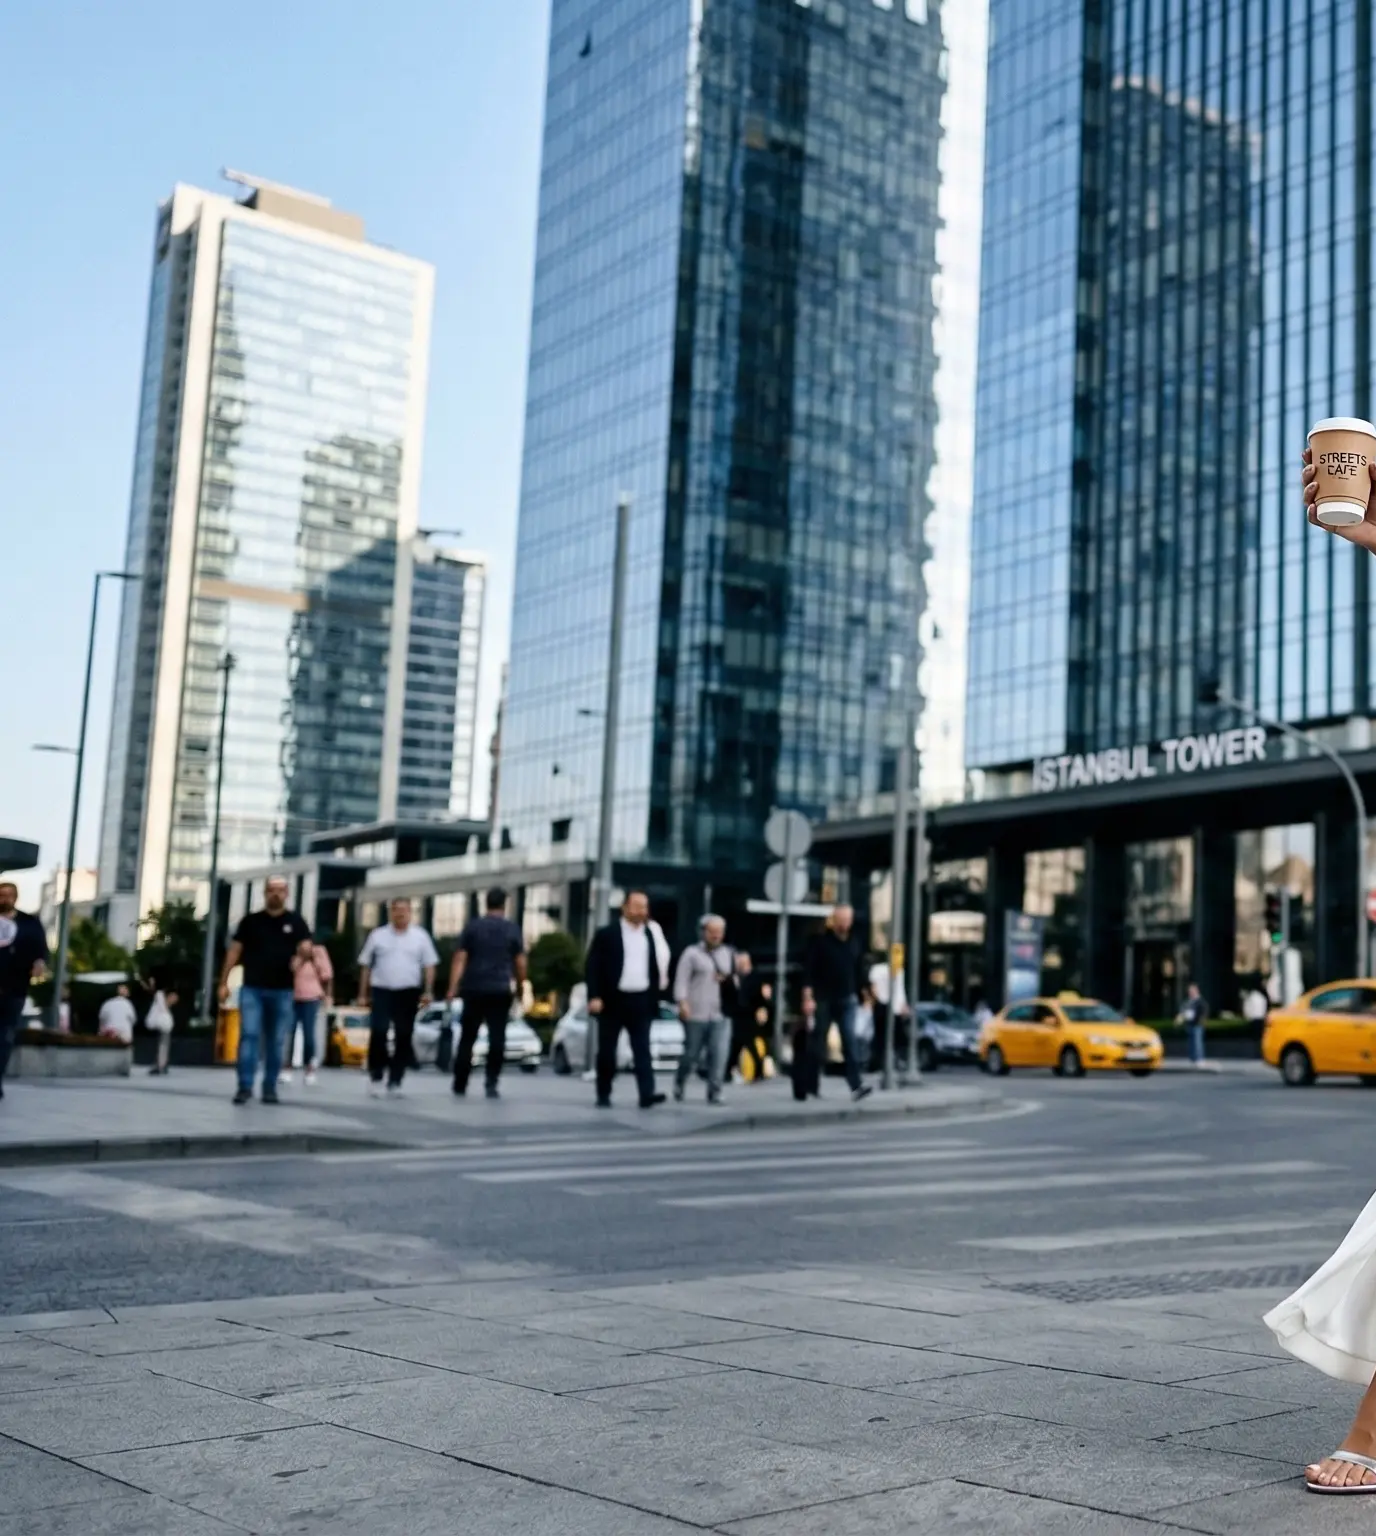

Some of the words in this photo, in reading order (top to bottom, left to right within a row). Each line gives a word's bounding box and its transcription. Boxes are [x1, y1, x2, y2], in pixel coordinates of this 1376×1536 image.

[1319, 452, 1367, 467] STREETS
[1327, 464, 1357, 476] CAFE
[1161, 727, 1266, 773] TOWER
